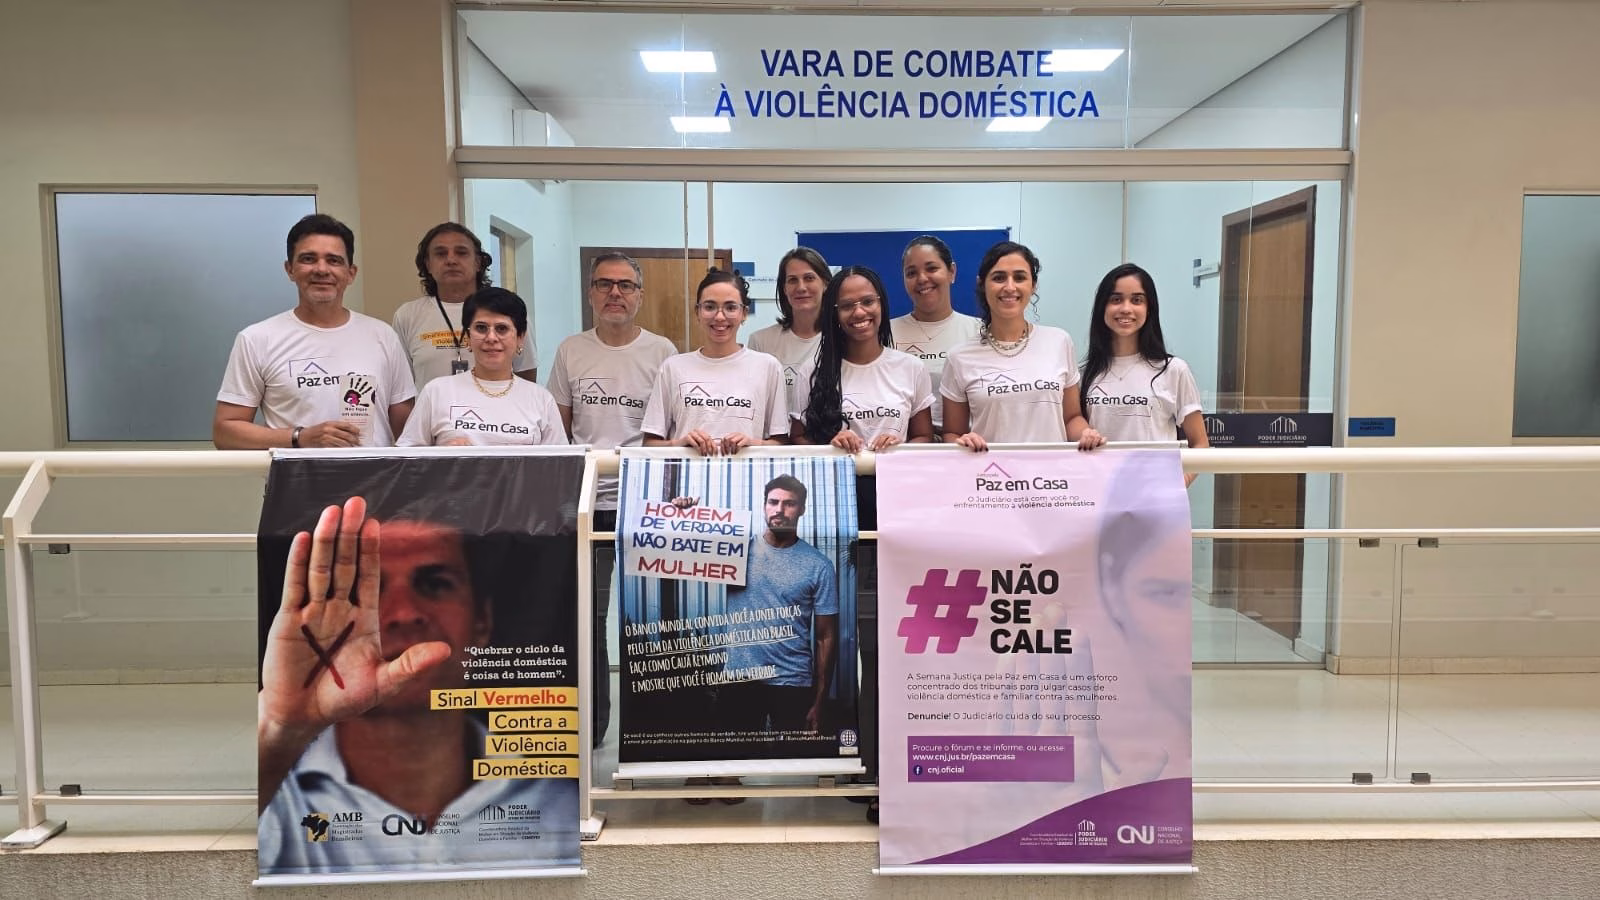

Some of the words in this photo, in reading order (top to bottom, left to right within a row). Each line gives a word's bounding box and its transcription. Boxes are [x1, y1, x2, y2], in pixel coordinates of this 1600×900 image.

[760, 50, 844, 77] VARA
[854, 50, 893, 77] DE
[904, 49, 1053, 78] COMBATE
[714, 84, 735, 118] À
[745, 84, 910, 118] VIOLÊNCIA
[920, 84, 1099, 118] DOMÉSTICA
[297, 376, 321, 388] Paz
[987, 385, 1009, 396] Paz
[1012, 383, 1032, 392] em
[1034, 380, 1059, 391] Casa
[581, 394, 598, 405] Paz
[600, 396, 617, 405] em
[619, 395, 644, 409] Casa
[684, 397, 704, 407] Paz
[706, 398, 724, 407] em
[726, 397, 751, 408] Casa
[1102, 397, 1120, 405] em
[1122, 395, 1148, 406] Casa
[856, 410, 874, 419] em
[876, 406, 900, 418] Casa
[455, 420, 476, 430] Paz
[478, 423, 498, 432] em
[501, 423, 529, 434] Casa
[976, 478, 1002, 491] Paz
[1005, 480, 1029, 491] em
[1033, 477, 1068, 490] Casa
[645, 502, 732, 522] HOMEM
[640, 516, 664, 529] DE
[671, 520, 744, 536] VERDADE
[632, 532, 666, 548] NÃO
[671, 538, 713, 553] BATE
[717, 542, 744, 557] EM
[638, 556, 737, 580] MULHER
[991, 563, 1059, 595] NÃO
[990, 599, 1032, 624] SE
[625, 625, 631, 637] O
[632, 622, 657, 636] BANCO
[658, 619, 693, 633] MUNDIAL
[694, 612, 729, 629] CONVIDA
[730, 607, 749, 624] VOCÊ
[749, 610, 754, 621] A
[755, 608, 776, 620] UNIR
[776, 604, 801, 621] FORÇAS
[627, 643, 644, 656] PELO
[646, 640, 661, 653] FIM
[662, 639, 672, 652] DA
[673, 633, 714, 650] VIOLÊNCIA
[715, 628, 757, 646] DOMÉSTICA
[757, 629, 769, 640] NO
[770, 624, 794, 639] BRASIL
[990, 629, 1073, 654] CALE
[464, 646, 513, 656] “Quebrar
[524, 645, 550, 654] ciclo
[552, 645, 565, 653] da
[461, 658, 511, 668] violência
[513, 657, 567, 666] doméstica
[648, 659, 670, 672] COMO
[671, 653, 691, 670] CAUÃ
[692, 652, 728, 667] REYMOND
[463, 671, 469, 680] é
[472, 671, 499, 680] coisa
[502, 671, 514, 679] de
[632, 681, 636, 693] E
[638, 678, 665, 692] MOSTRE
[666, 676, 680, 692] QUE
[681, 670, 699, 687] VOCÊ
[701, 670, 705, 685] É
[706, 669, 734, 685] HOMEM
[736, 669, 744, 680] DE
[746, 665, 776, 680] VERDADE
[953, 673, 982, 682] Justiça
[984, 673, 1002, 682] pela
[1086, 674, 1118, 682] esforço
[907, 682, 960, 690] concentrado
[962, 682, 978, 690] dos
[980, 682, 1018, 690] tribunais
[1020, 684, 1039, 692] para
[1041, 683, 1065, 692] julgar
[438, 690, 477, 707] Sinal
[483, 689, 567, 705] Vermelho
[907, 692, 944, 700] violência
[946, 692, 991, 700] doméstica
[1001, 692, 1032, 700] familiar
[1034, 693, 1062, 701] contra
[494, 714, 552, 729] Contra
[558, 717, 567, 728] a
[907, 712, 951, 720] Denuncie!
[962, 712, 1004, 720] Judiciário
[1005, 712, 1030, 720] cuida
[1031, 712, 1043, 720] do
[1063, 714, 1102, 722] processo.
[491, 737, 567, 753] Violência
[912, 744, 942, 752] Procure
[913, 753, 1016, 762] www.cnj.jus.br/pazemcasa
[478, 760, 567, 776] Doméstica
[927, 766, 965, 775] cnj.oficial
[332, 812, 363, 822] AMB
